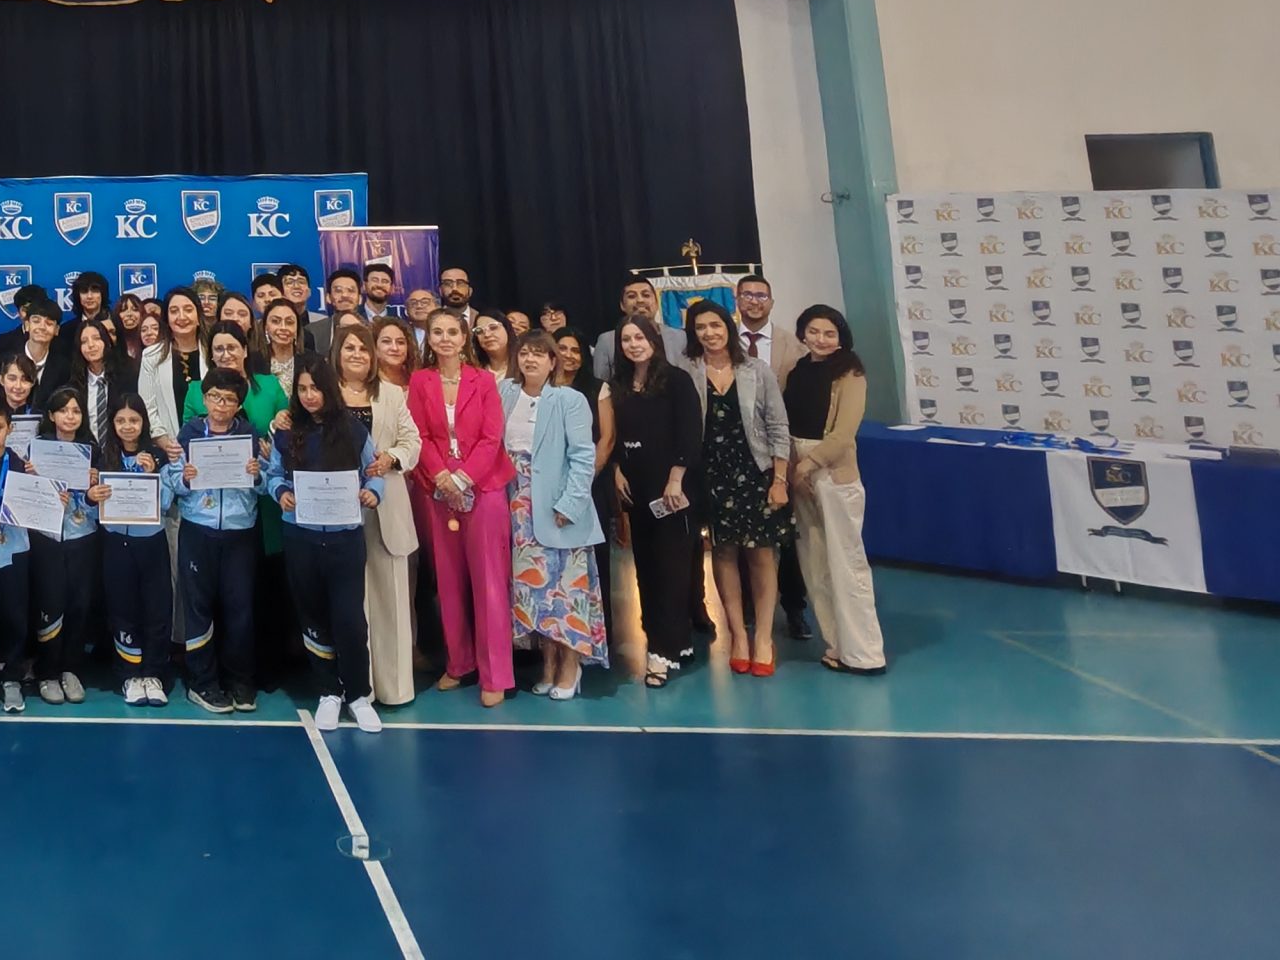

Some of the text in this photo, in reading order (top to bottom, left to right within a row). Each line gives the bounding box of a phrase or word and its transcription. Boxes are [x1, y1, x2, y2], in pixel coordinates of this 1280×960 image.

[66, 202, 82, 213] KC
[193, 200, 210, 210] KC
[325, 200, 343, 210] KC
[1198, 205, 1230, 218] KC
[936, 209, 960, 221] KC
[1017, 207, 1044, 220] KC
[1104, 206, 1132, 219] KC
[115, 214, 158, 239] KC
[247, 213, 291, 238] KC
[900, 242, 924, 254] KC
[980, 242, 1006, 254] KC
[1064, 241, 1092, 254] KC
[1156, 242, 1185, 255] KC
[5, 275, 21, 285] KC
[130, 274, 147, 285] KC
[943, 275, 969, 288] KC
[1027, 275, 1052, 289] KC
[1115, 277, 1142, 291] KC
[1209, 279, 1239, 293] KC
[55, 288, 74, 311] K
[907, 308, 933, 321] KC
[989, 309, 1015, 323] KC
[1074, 312, 1102, 325] KC
[1166, 314, 1196, 329] KC
[951, 342, 977, 356] KC
[1035, 345, 1062, 358] KC
[1124, 349, 1153, 363] KC
[1221, 353, 1251, 367] KC
[915, 374, 940, 388] KC
[996, 379, 1023, 392] KC
[1082, 383, 1113, 398] KC
[1177, 388, 1208, 403] KC
[958, 412, 985, 425] KC
[1044, 417, 1071, 431] KC
[1134, 424, 1164, 439] KC
[1232, 430, 1263, 445] KC
